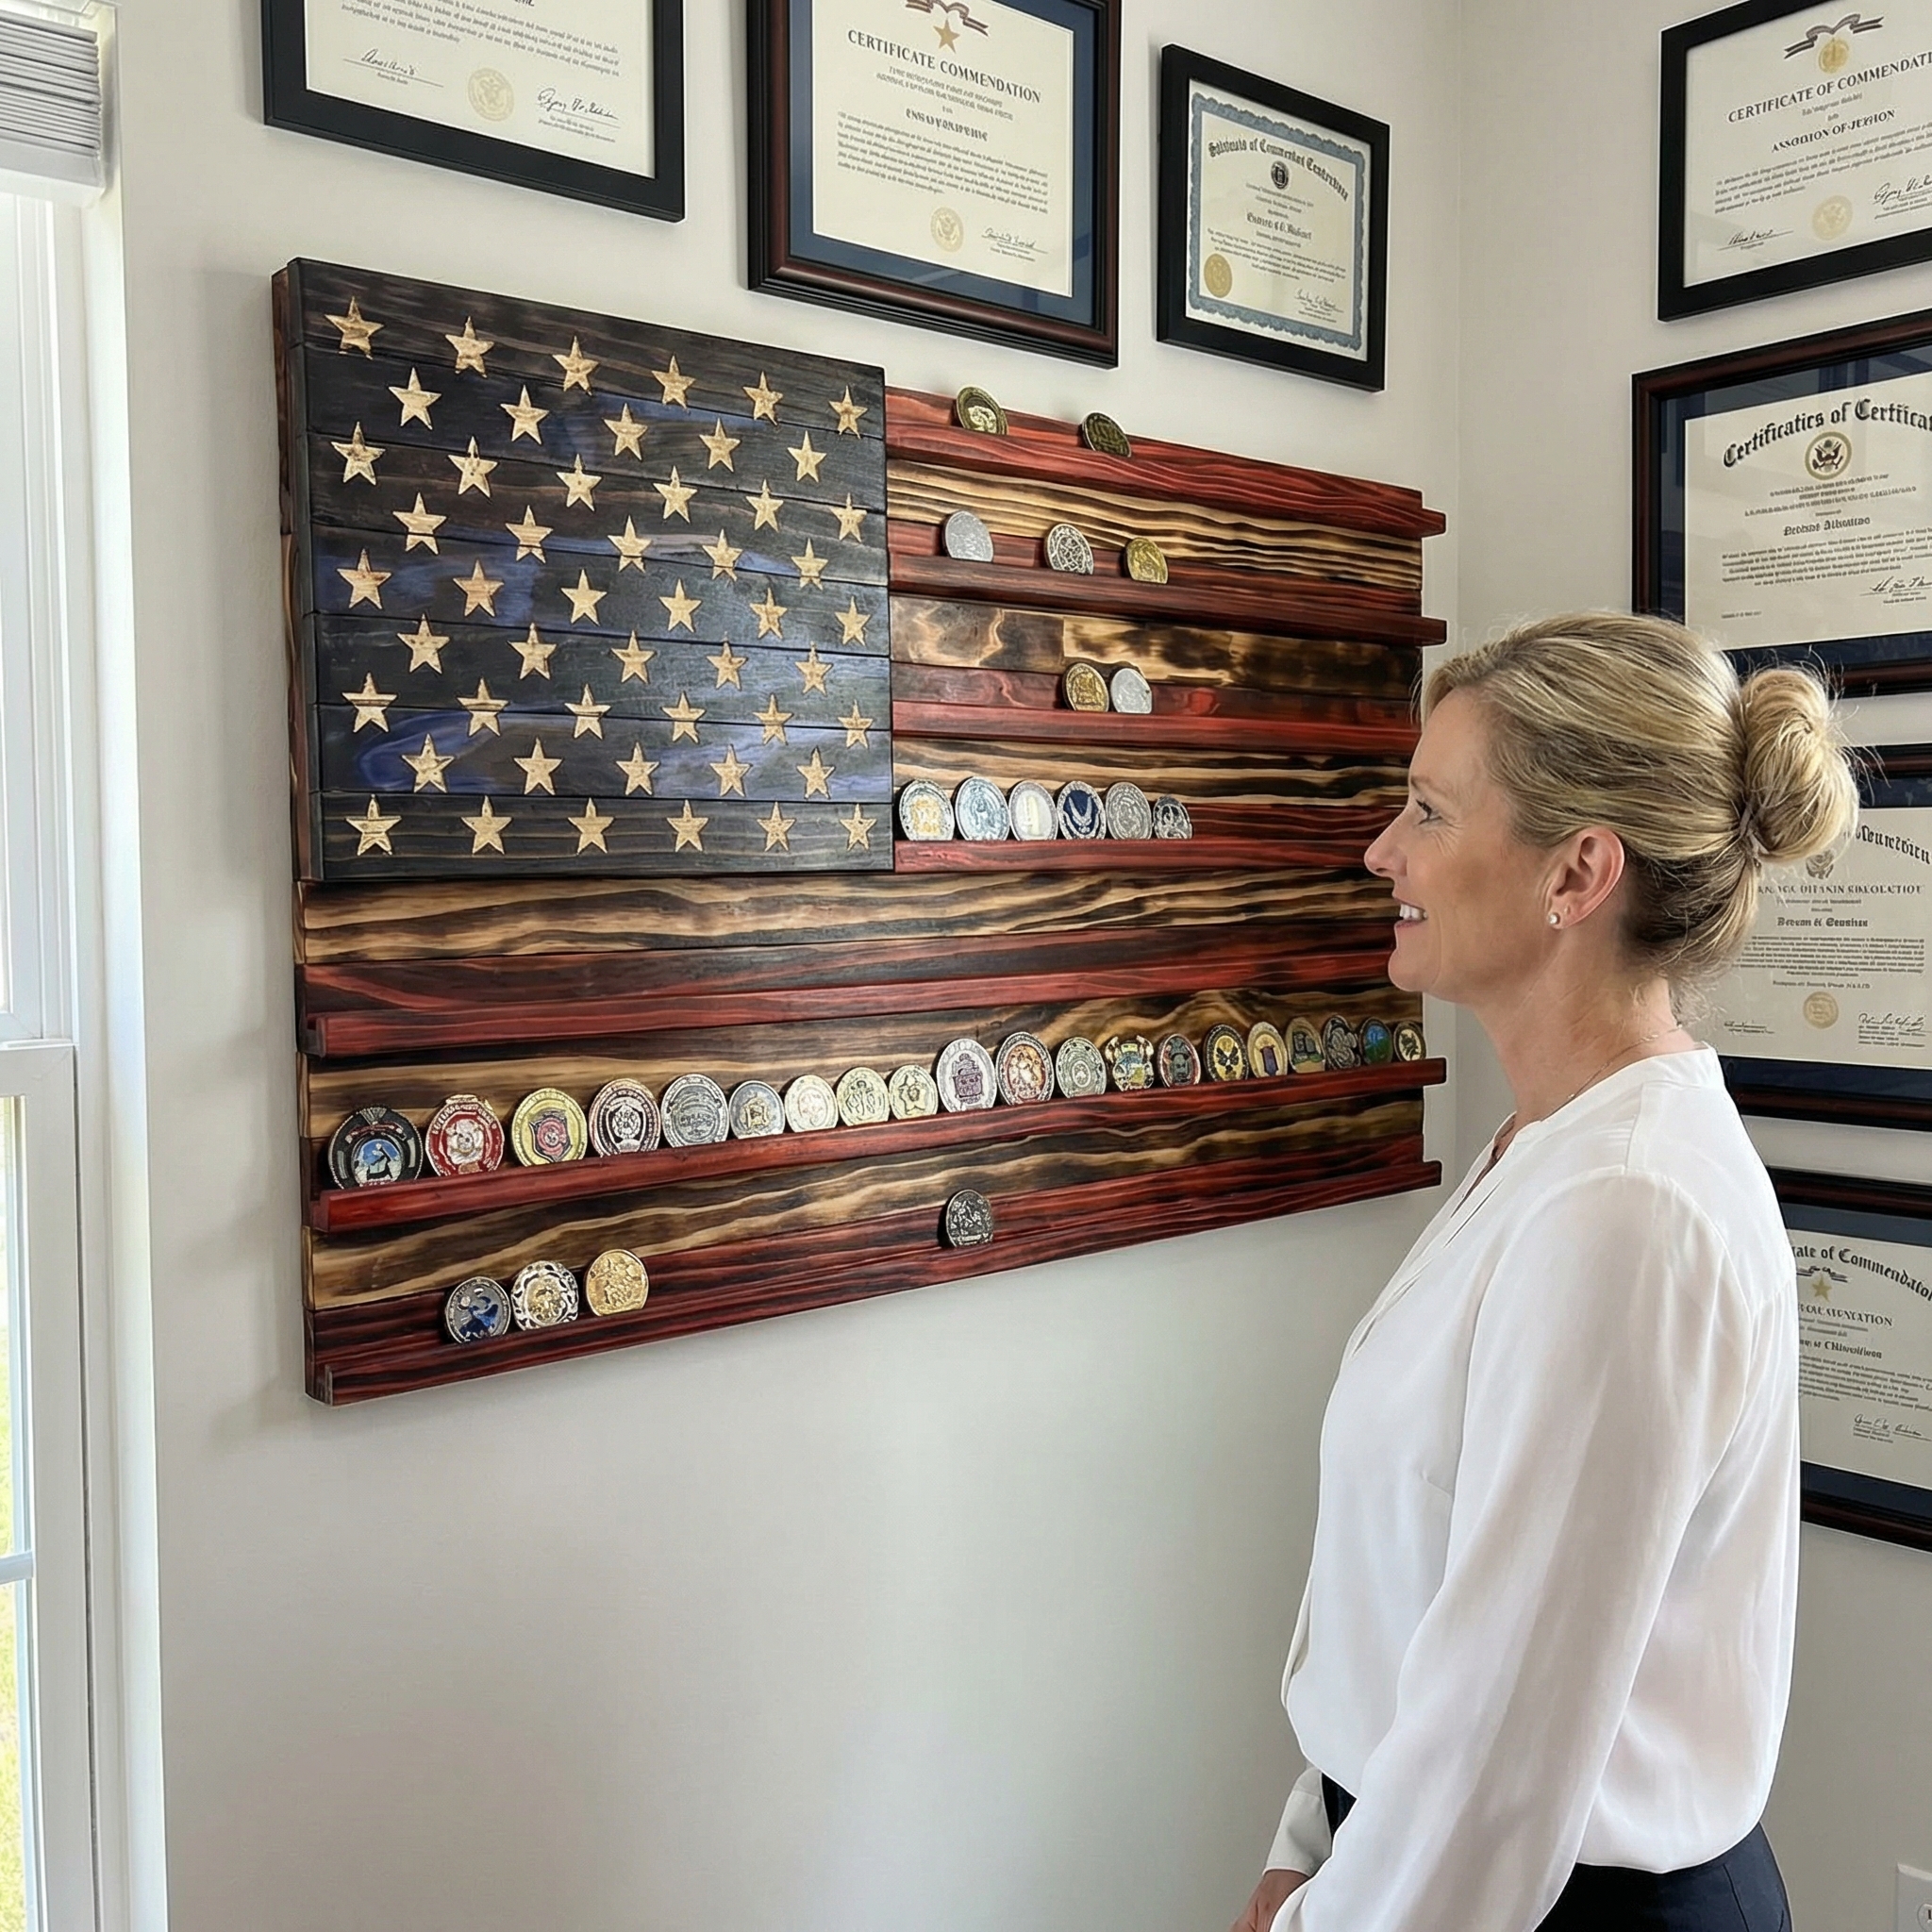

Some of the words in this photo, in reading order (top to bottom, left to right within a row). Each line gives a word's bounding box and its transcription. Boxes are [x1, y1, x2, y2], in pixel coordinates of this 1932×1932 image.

[848, 29, 936, 70] CERTIFICATE
[940, 60, 1041, 104] COMMENDATION
[1727, 87, 1814, 123] CERTIFICATE
[1816, 81, 1835, 96] OF
[1830, 402, 1852, 425] of
[1821, 1245, 1835, 1260] of
